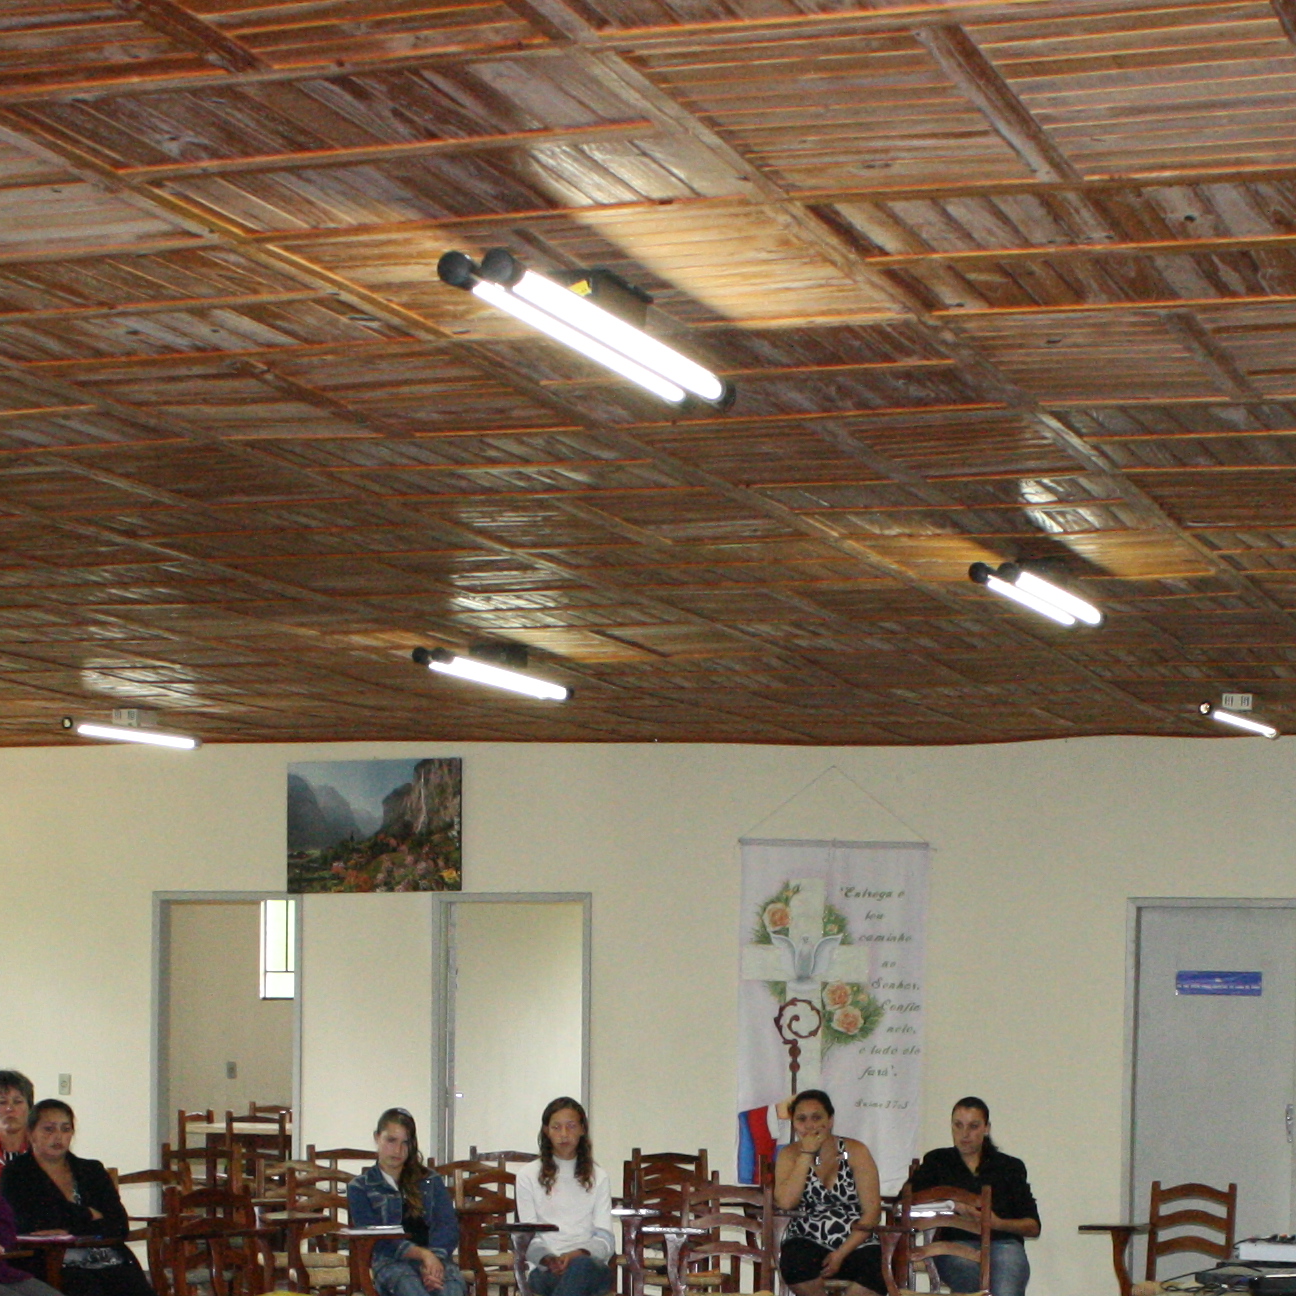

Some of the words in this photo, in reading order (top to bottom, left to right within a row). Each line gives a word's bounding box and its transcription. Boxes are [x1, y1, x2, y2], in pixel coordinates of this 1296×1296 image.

[858, 933, 912, 942] caminho
[881, 960, 896, 968] ao
[870, 1045, 898, 1055] tudo
[902, 1045, 921, 1055] ele
